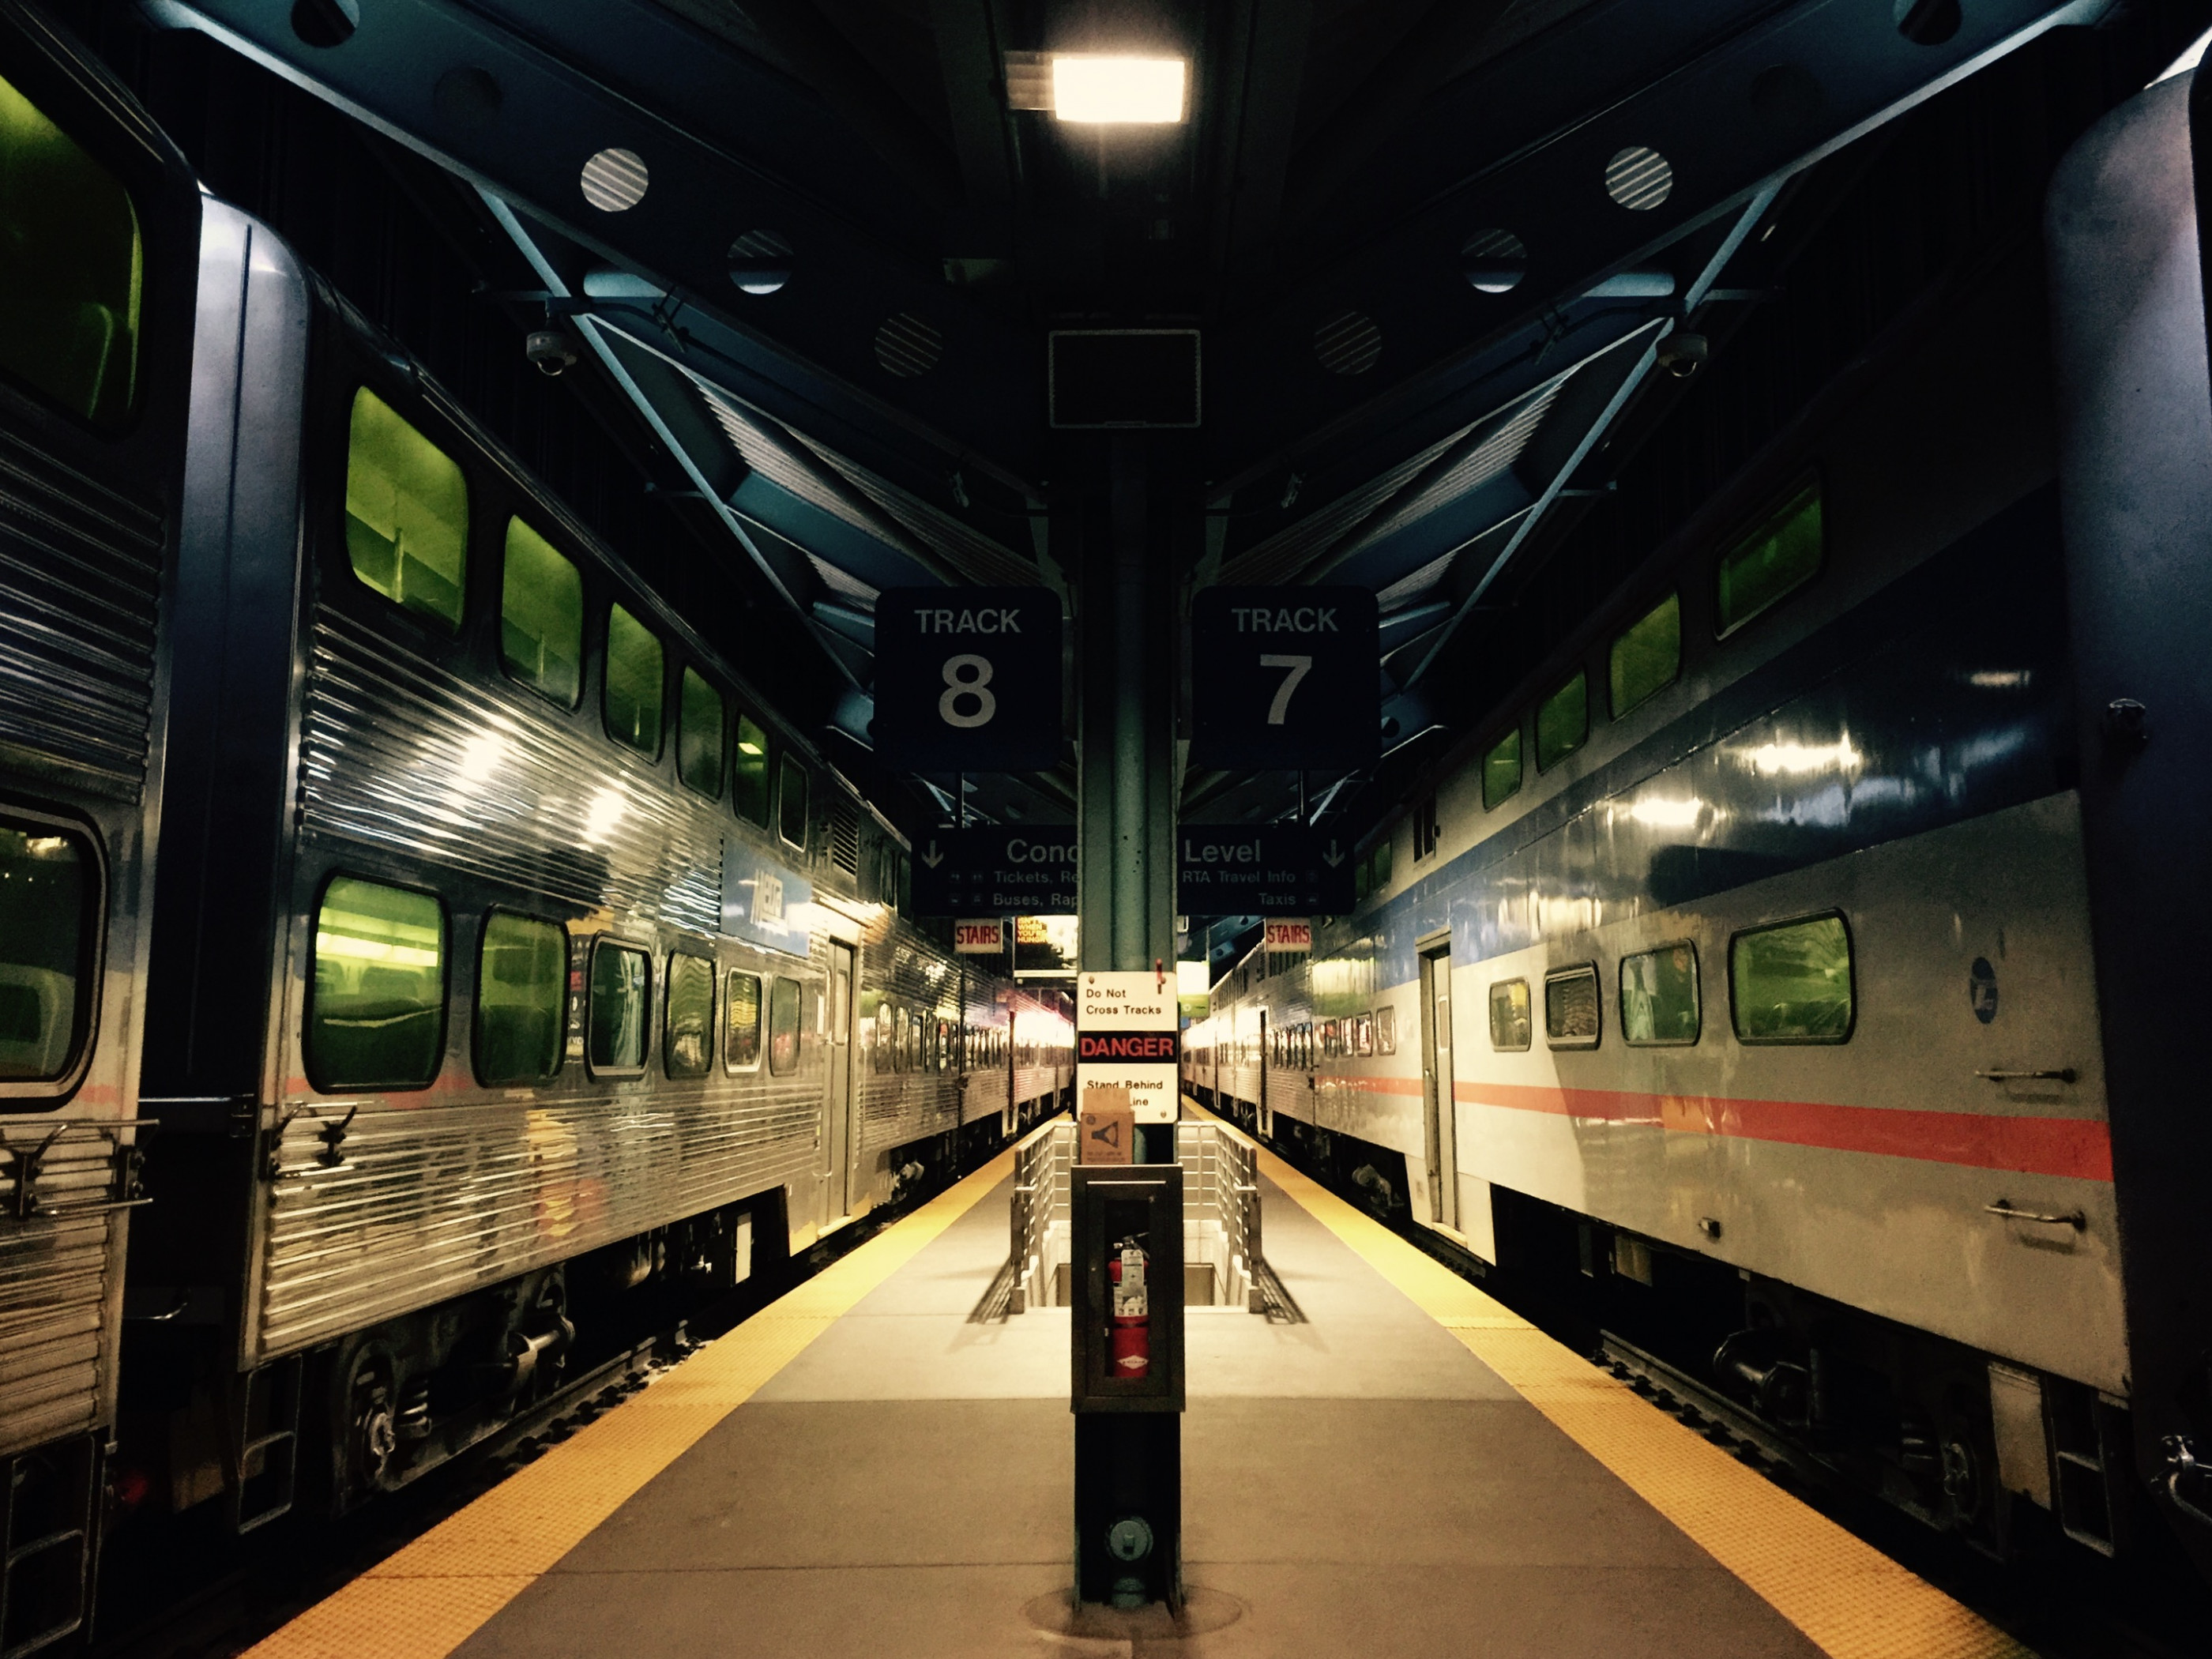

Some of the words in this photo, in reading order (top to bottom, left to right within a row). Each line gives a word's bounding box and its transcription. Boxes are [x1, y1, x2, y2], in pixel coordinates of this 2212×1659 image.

[913, 608, 1022, 634] TRACK
[1231, 607, 1339, 633] TRACK
[938, 653, 997, 728] 8
[1260, 653, 1312, 725] 7
[1184, 838, 1261, 863] Level
[994, 871, 1053, 884] Tickets,
[1182, 871, 1211, 883] RTA
[1217, 870, 1261, 883] Travel
[1267, 870, 1296, 883] Info
[992, 893, 1044, 907] Buses,
[1258, 893, 1297, 906] Taxis
[957, 925, 999, 945] STAIRS
[1267, 924, 1310, 944] STAIRS
[1086, 988, 1101, 999] Do
[1106, 988, 1127, 999] Not
[1085, 1005, 1119, 1015] Cross
[1123, 1005, 1162, 1015] Tracks
[1080, 1036, 1174, 1057] DANGER
[1086, 1079, 1119, 1089] Stand
[1125, 1079, 1164, 1089] Behind
[1130, 1097, 1149, 1106] ine
